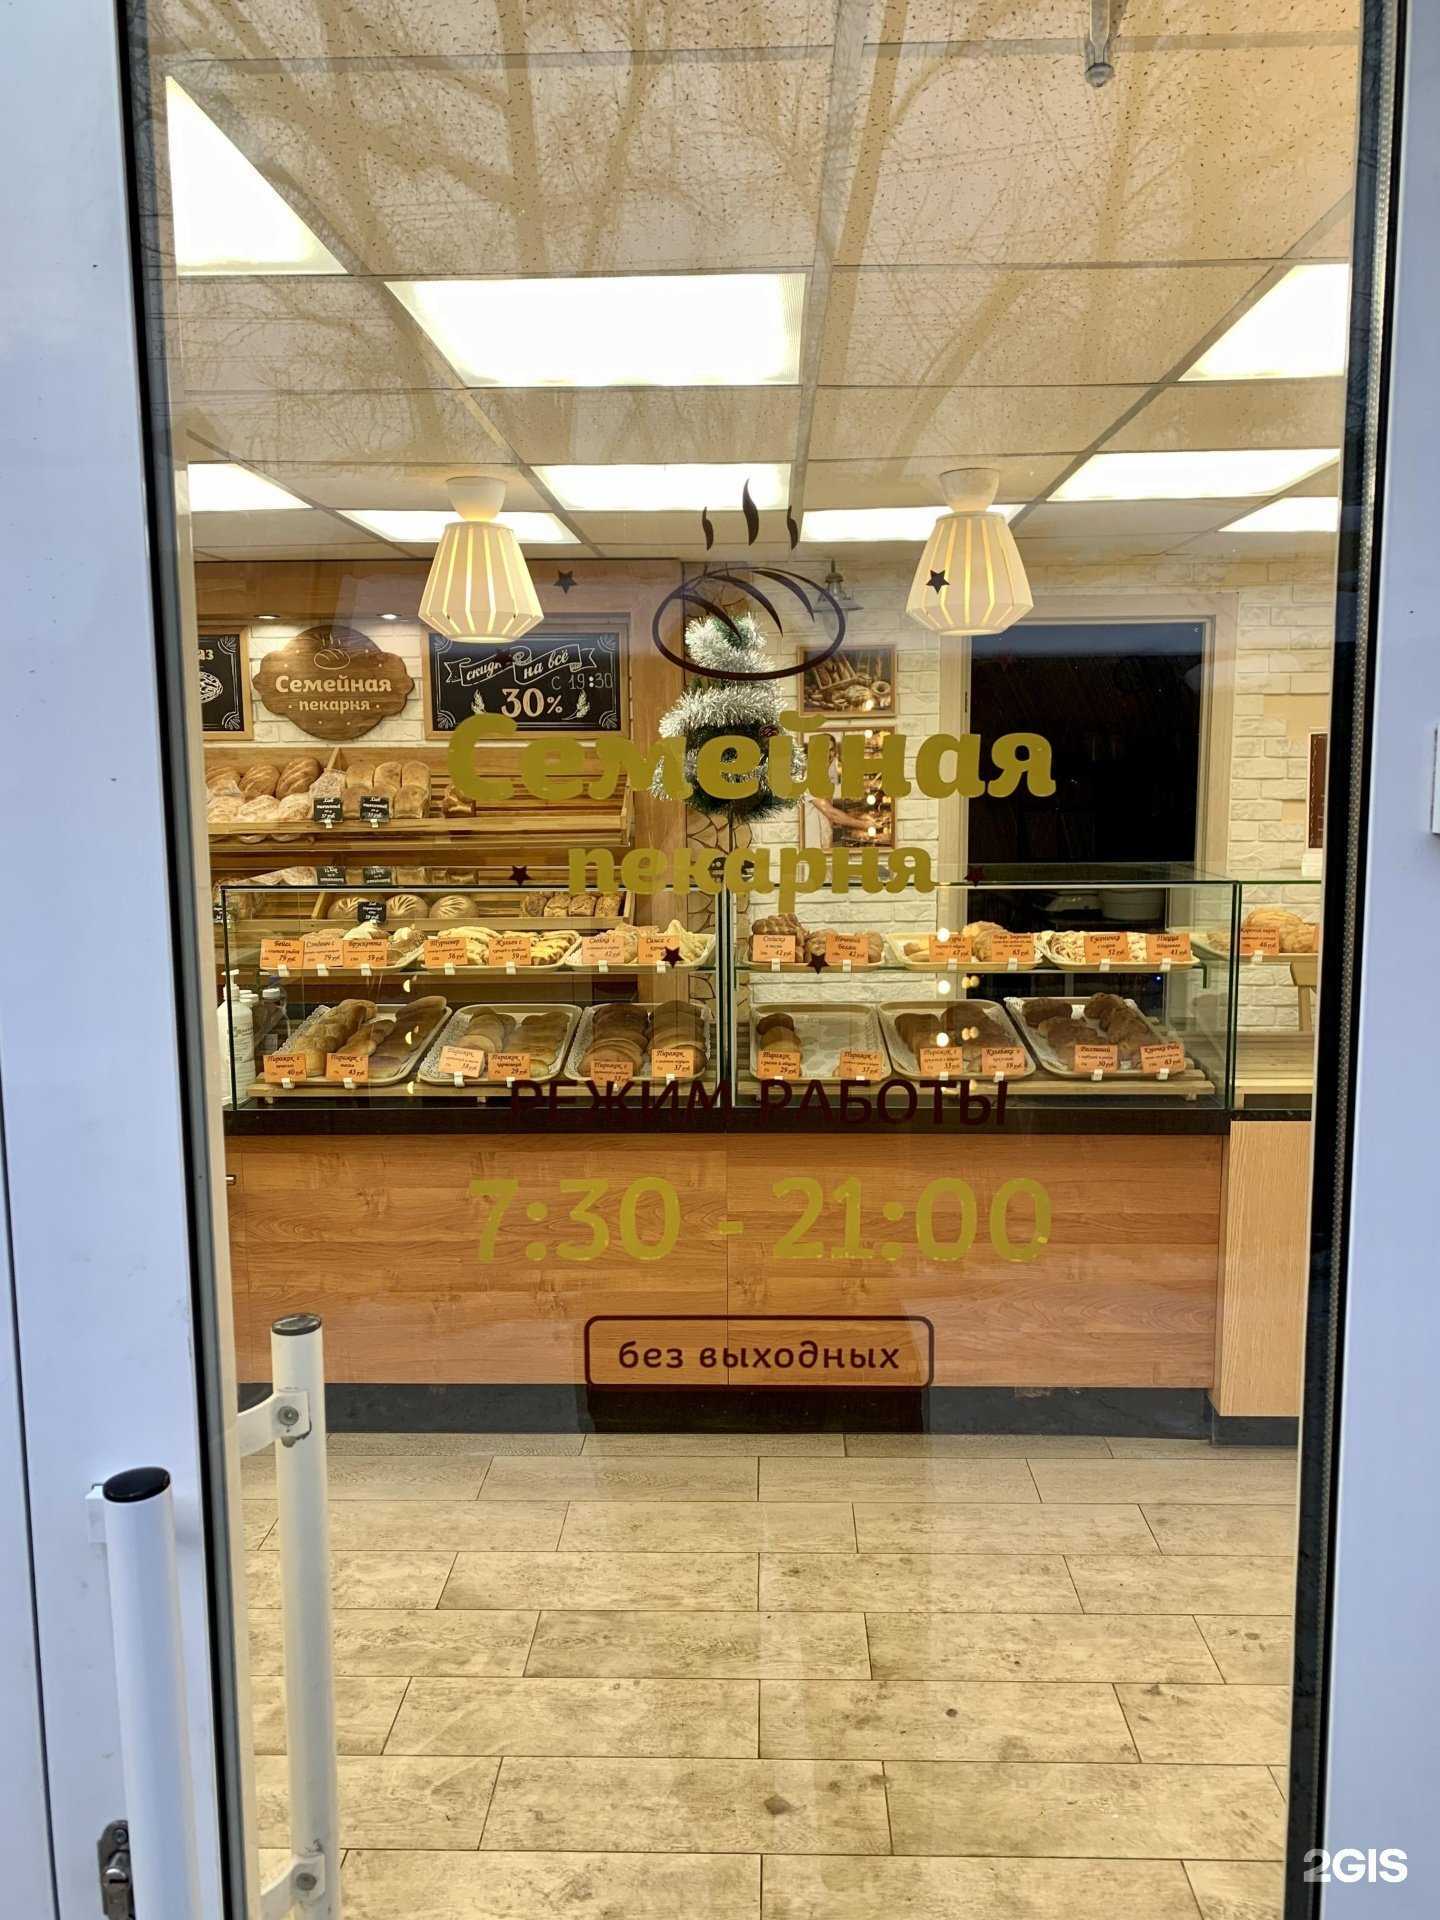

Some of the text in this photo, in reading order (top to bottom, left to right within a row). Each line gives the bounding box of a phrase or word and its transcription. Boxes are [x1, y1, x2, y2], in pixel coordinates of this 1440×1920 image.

[275, 674, 392, 693] Семейная
[523, 662, 543, 679] на
[568, 672, 613, 689] 19:30
[299, 699, 370, 714] пекарня
[501, 687, 563, 718] 30%
[447, 710, 1056, 800] Семейная
[568, 846, 938, 916] пекарня
[511, 1079, 1008, 1125] РЕЖИМ РАБОТЫ
[470, 1176, 1052, 1263] 7:30 - 21:00
[619, 1340, 899, 1368] без выходных
